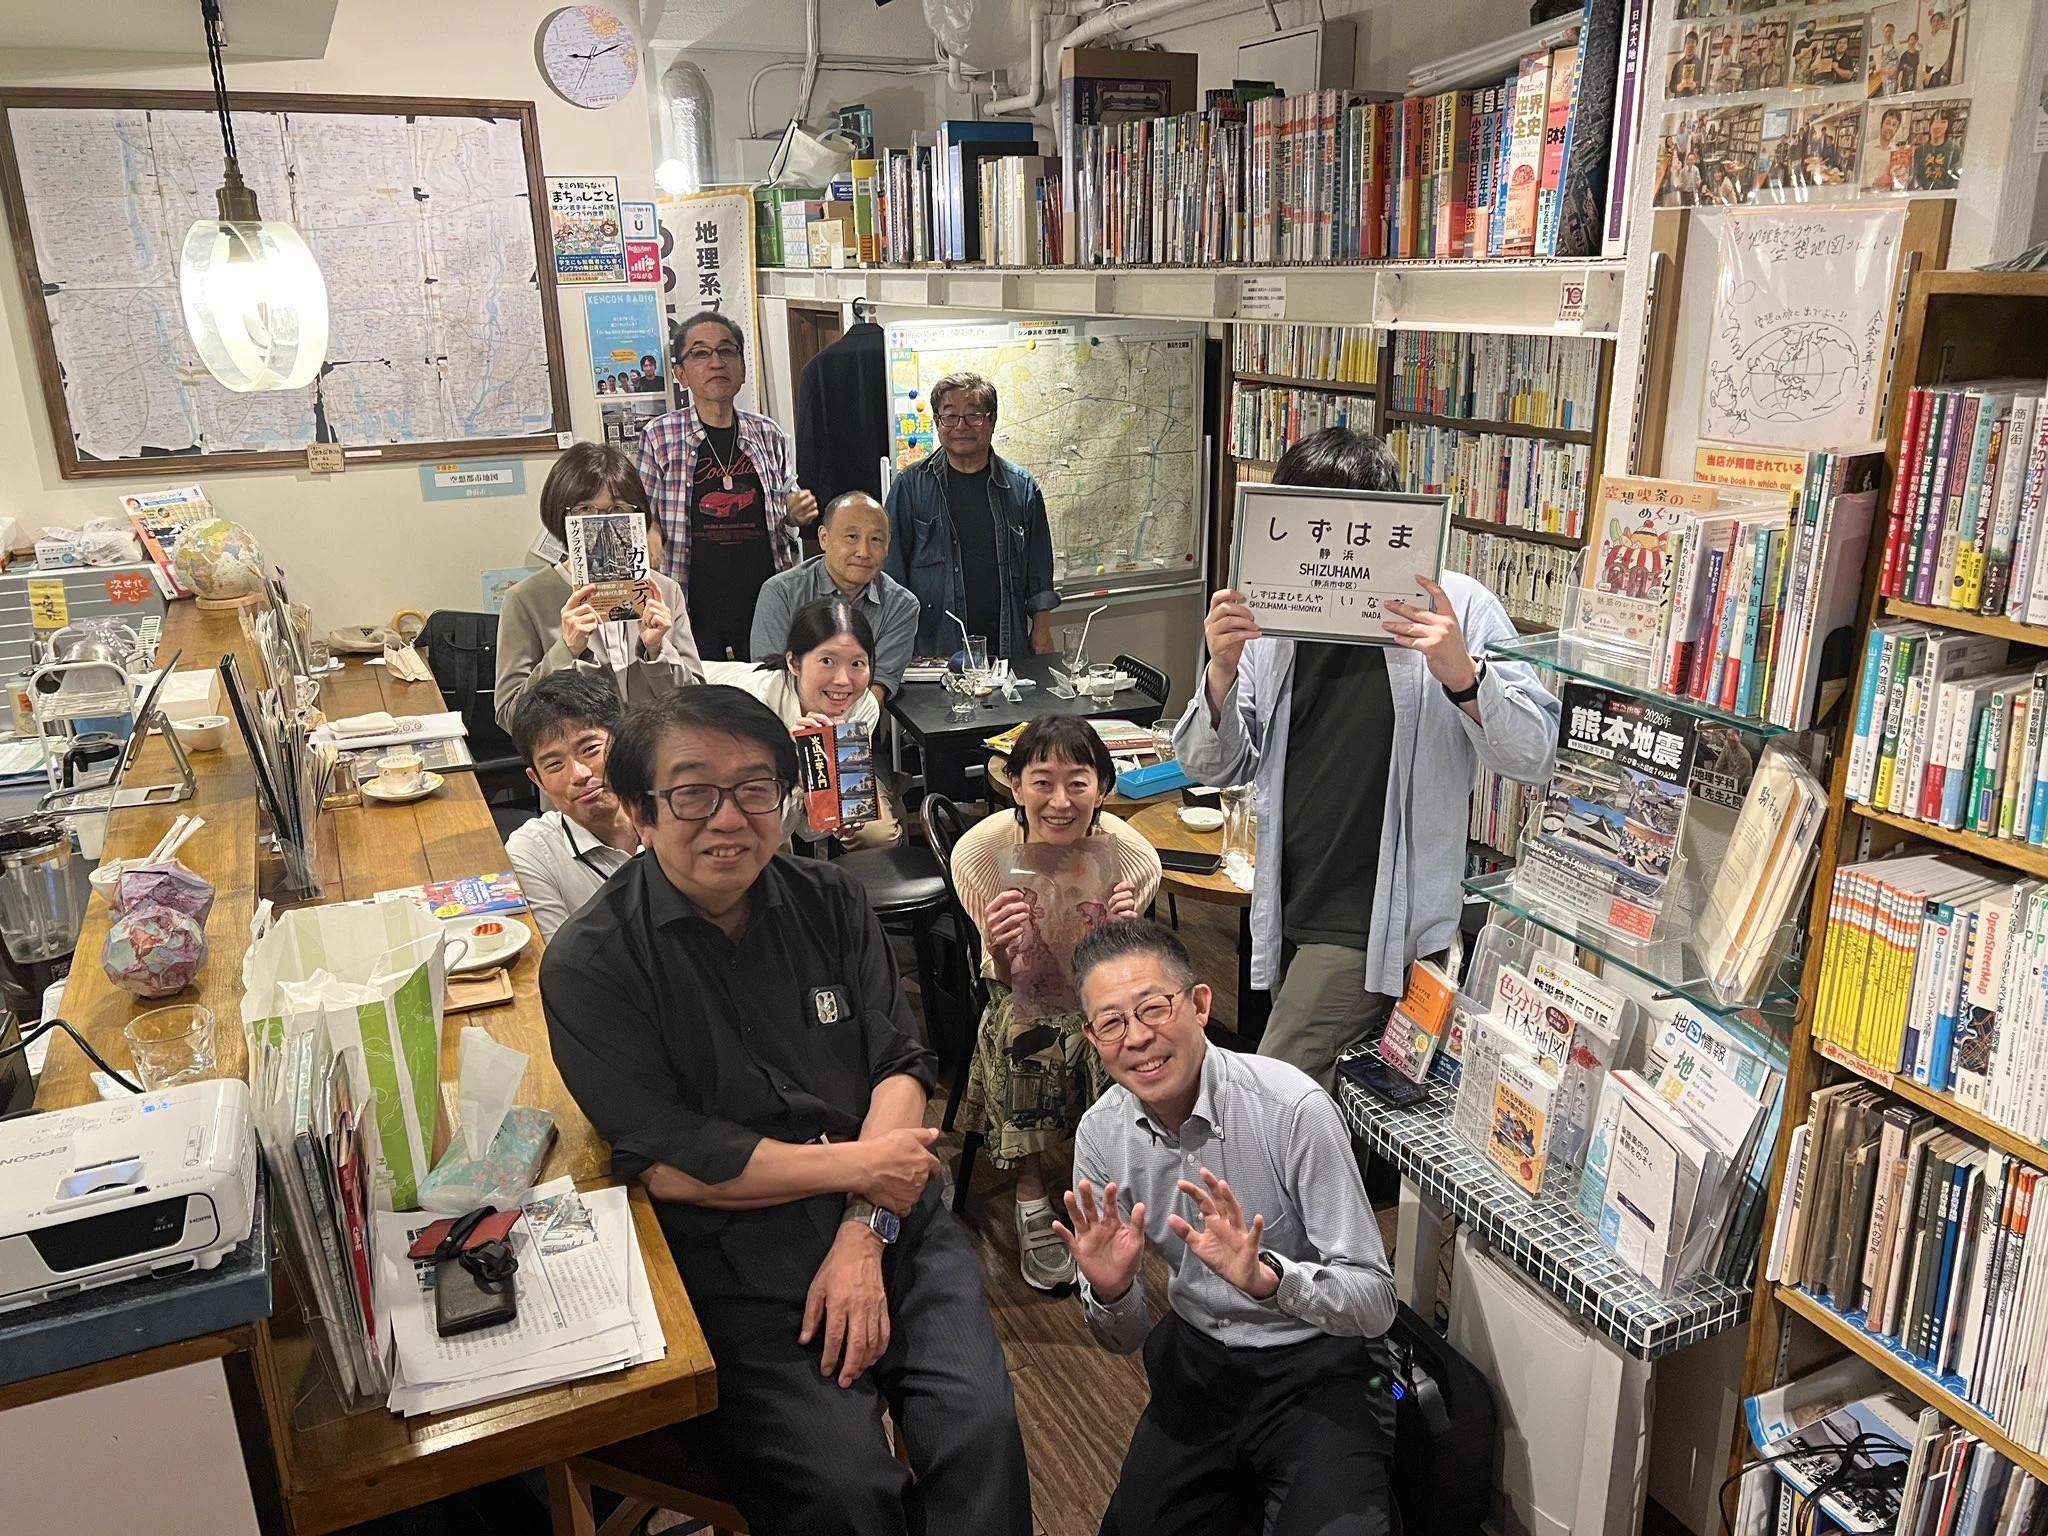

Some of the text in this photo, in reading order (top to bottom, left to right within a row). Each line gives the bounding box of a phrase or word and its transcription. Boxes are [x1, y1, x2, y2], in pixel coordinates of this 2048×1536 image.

[1627, 10, 1640, 73] 日本大地図
[1516, 93, 1543, 116] 世界
[1514, 117, 1541, 140] 全史
[552, 191, 614, 203] まちのしごと
[627, 245, 652, 255] Rakuten
[630, 272, 653, 280] つながる
[587, 293, 655, 305] KENCON RADIO
[2009, 407, 2028, 446] 商店街
[1706, 455, 1803, 475] 当店が掲載されている
[1932, 456, 1949, 495] 鎌倉街道
[449, 473, 499, 483] 空想都市地図
[1730, 476, 1747, 485] book
[1757, 479, 1778, 489] which
[1604, 485, 1685, 506] 空想喫茶の
[1637, 507, 1681, 525] めぐり
[1269, 516, 1413, 549] しずはま
[1994, 526, 2010, 536] 50
[569, 520, 588, 603] サグラダ・ファミリの
[1318, 548, 1355, 562] 静浜
[628, 545, 650, 608] ガウディ
[1299, 563, 1371, 580] SHIZUHAMA
[110, 578, 144, 588] 次世代
[113, 588, 149, 599] サーバー
[1249, 589, 1324, 602] しずはまひもんや
[1248, 600, 1322, 614] SHIZUHAMA-HIMONYA
[1361, 610, 1382, 620] INADA
[1719, 596, 1735, 638] やくみつる
[1744, 574, 1763, 647] 本屋百景
[1569, 706, 1685, 770] 熊本地震
[1951, 693, 1967, 762] くらべる東西
[2025, 895, 2039, 928] Software
[1977, 911, 2000, 995] OpenStreetMap
[1499, 973, 1544, 1024] 色分け
[1533, 977, 1609, 1028] 防災教育にGIS
[1504, 1004, 1567, 1065] 日本地図
[0, 1146, 67, 1167] EPSON
[1869, 1193, 1888, 1256] 大正時代の日本
